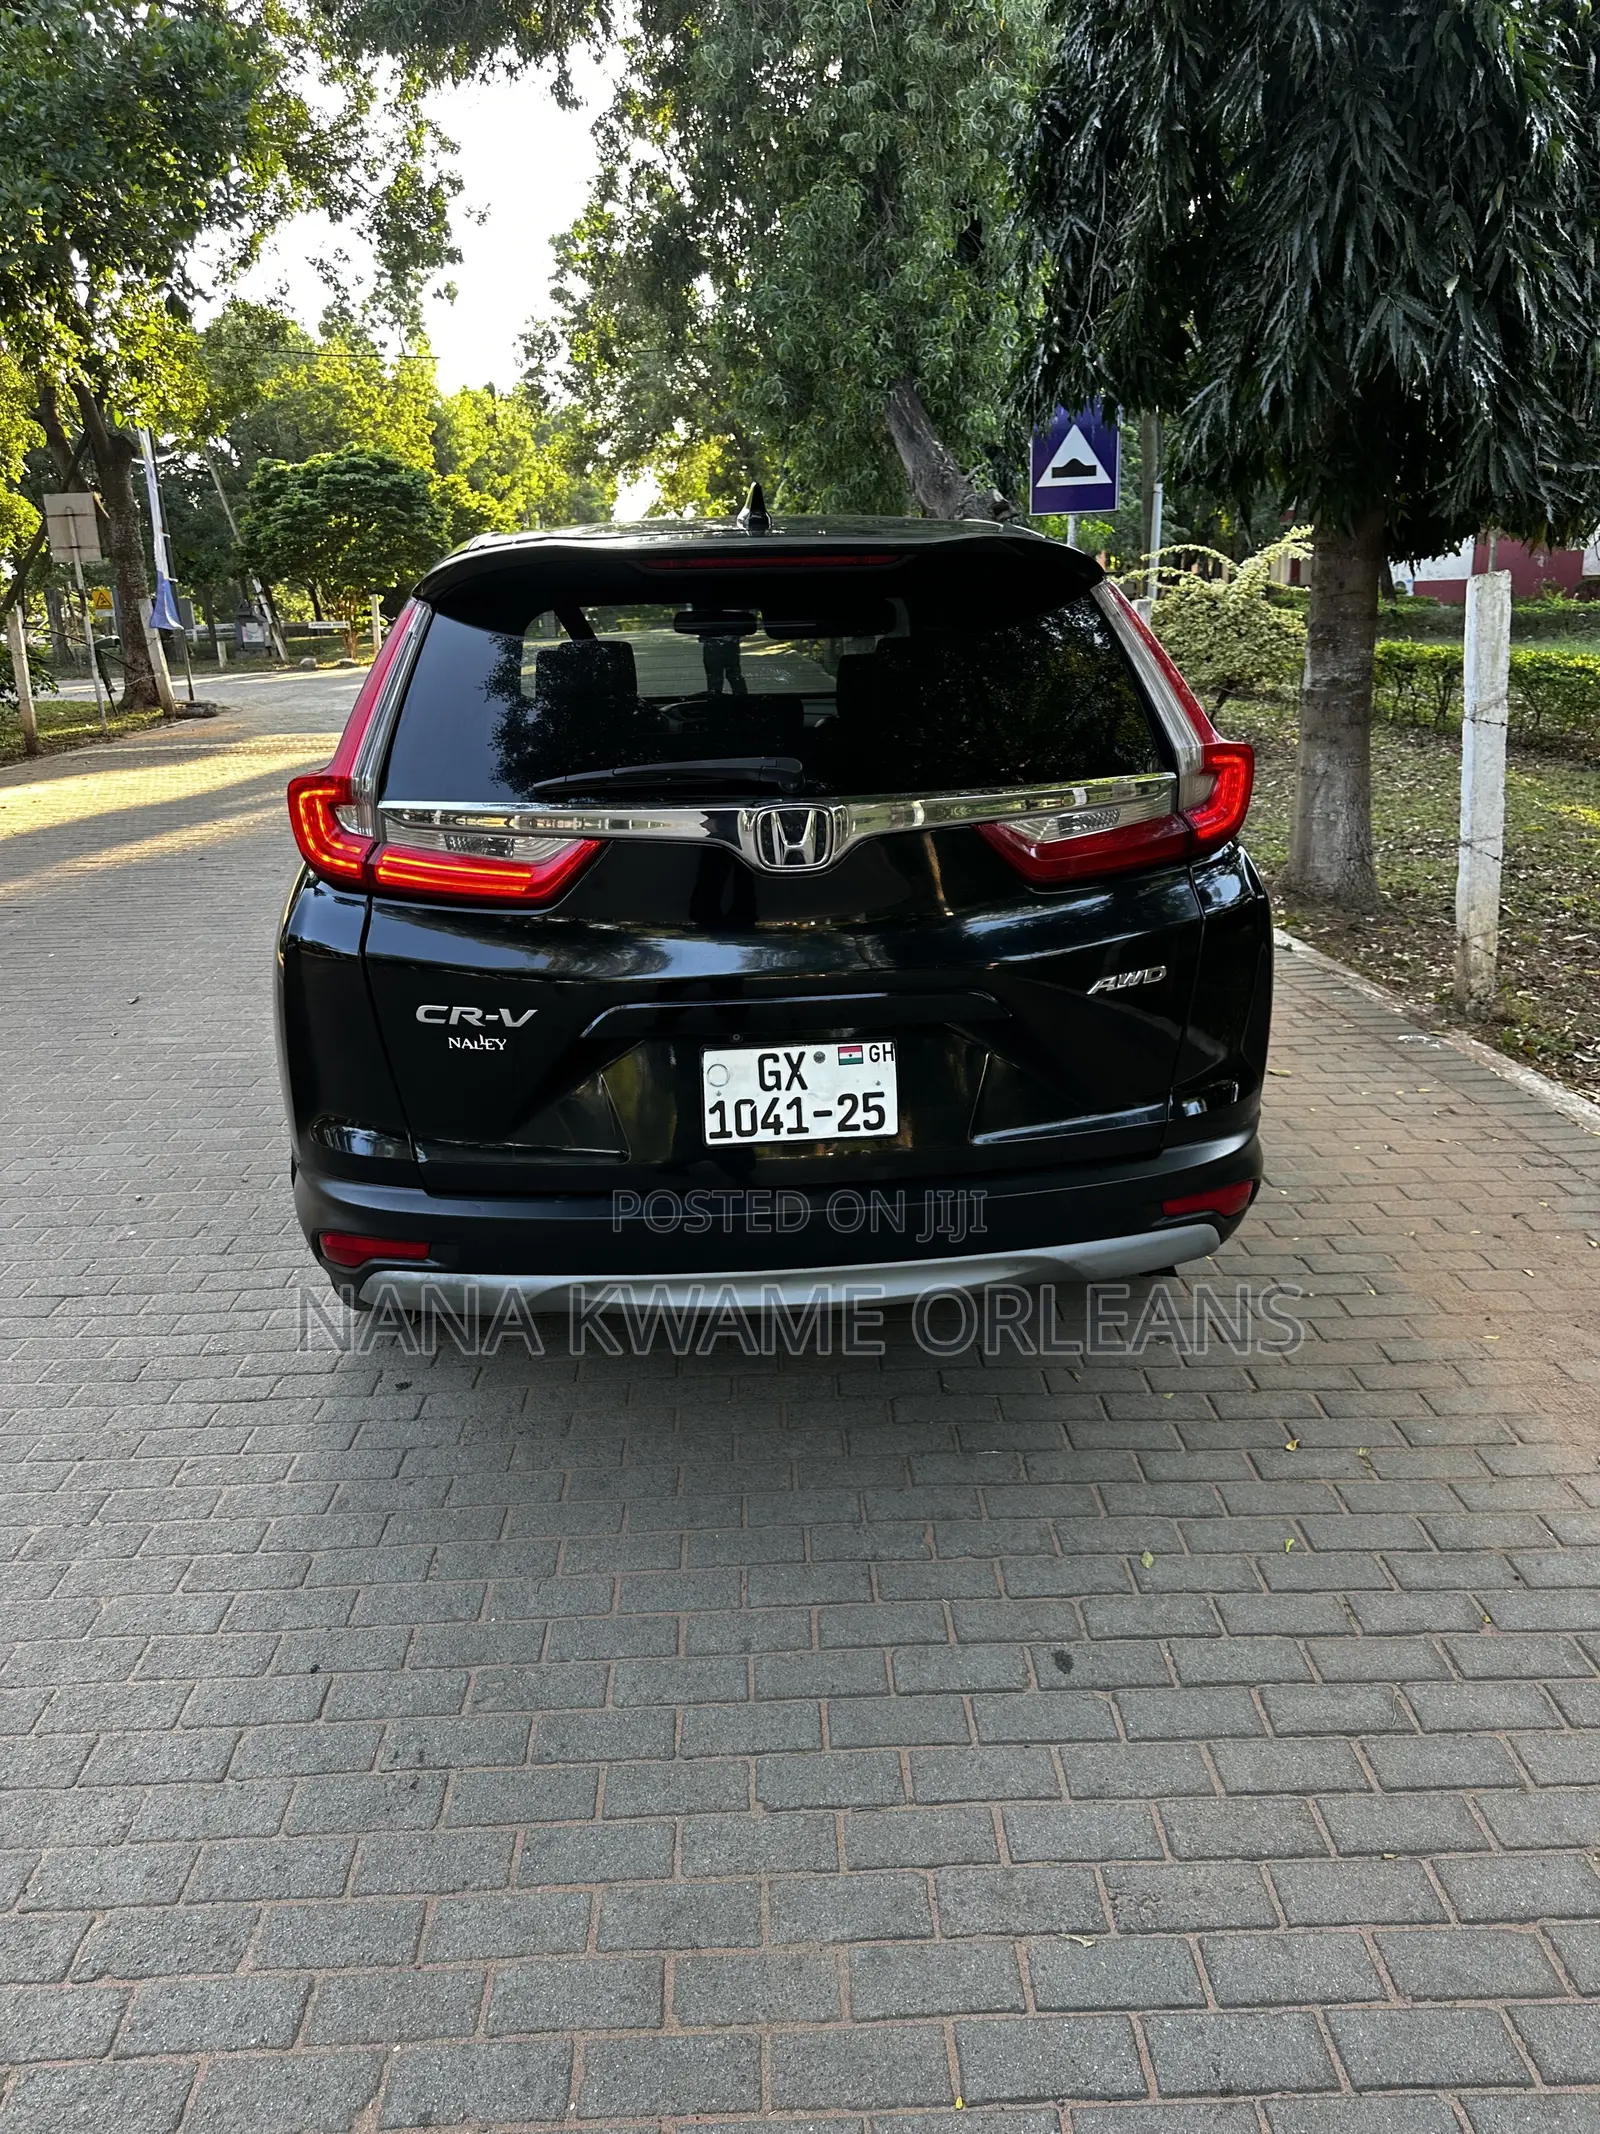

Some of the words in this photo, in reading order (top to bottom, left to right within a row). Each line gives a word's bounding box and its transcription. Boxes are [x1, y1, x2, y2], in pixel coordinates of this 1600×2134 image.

[1086, 965, 1167, 995] AWD
[415, 1004, 539, 1028] CR-V
[868, 1044, 895, 1063] GH
[757, 1051, 808, 1092] GX
[708, 1091, 886, 1139] 1041-25
